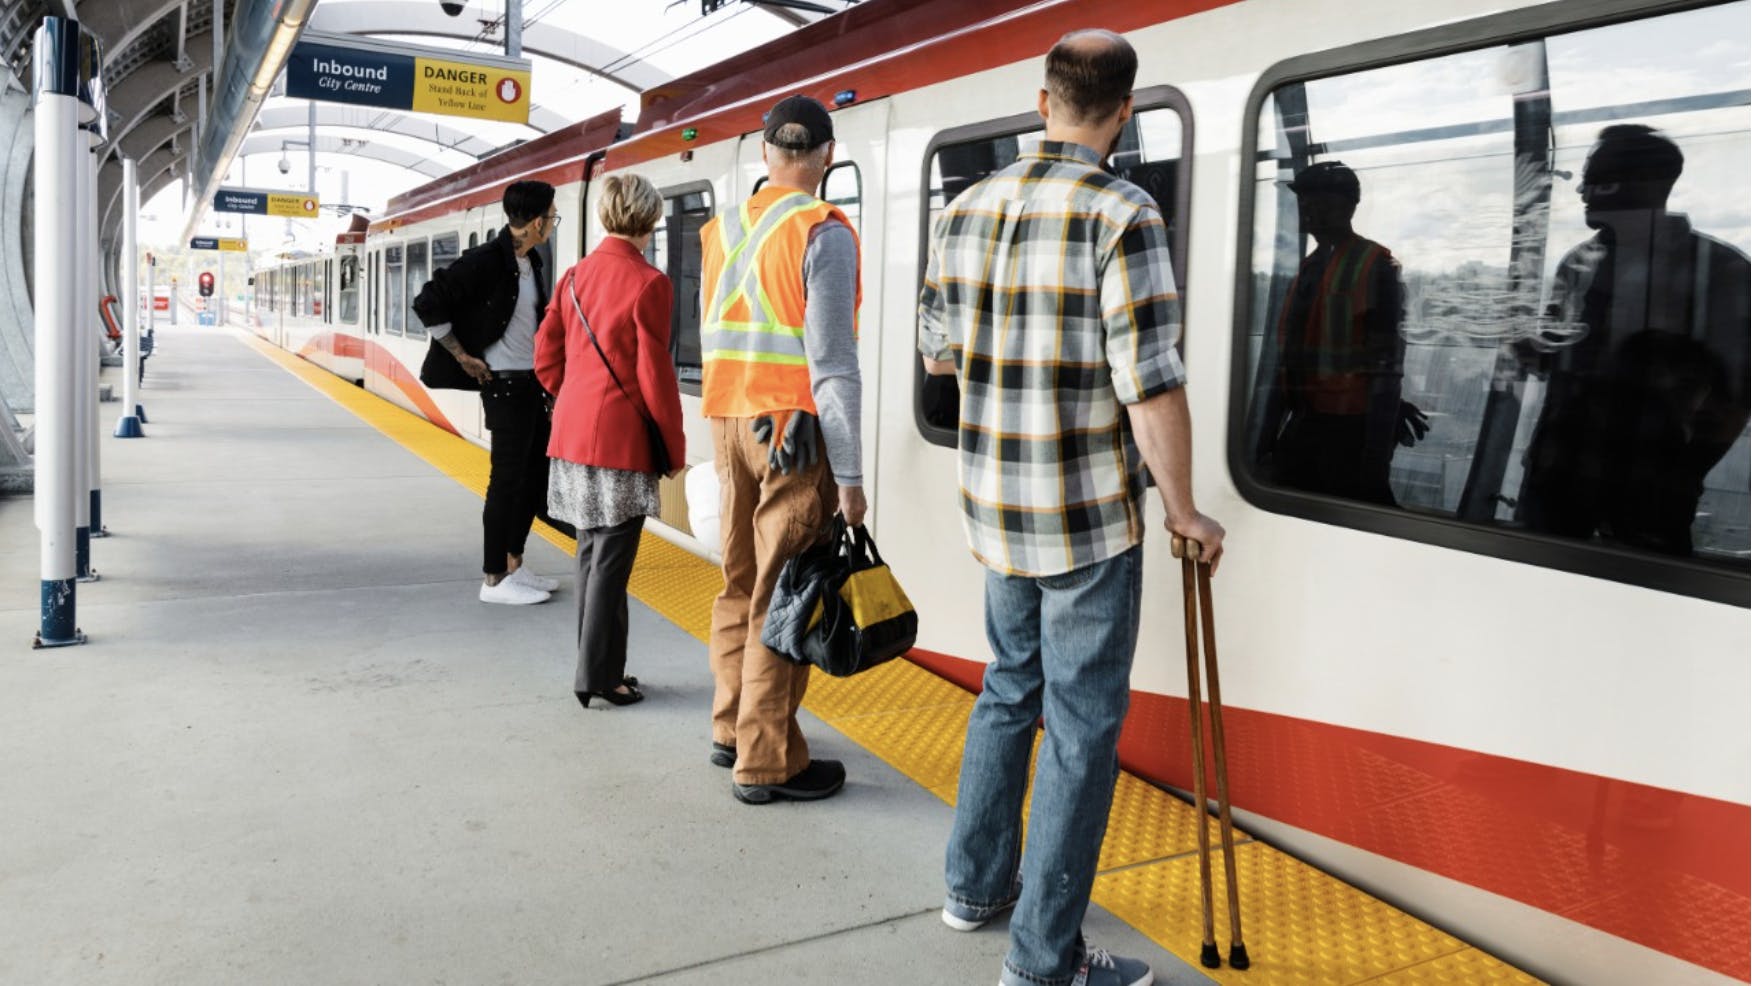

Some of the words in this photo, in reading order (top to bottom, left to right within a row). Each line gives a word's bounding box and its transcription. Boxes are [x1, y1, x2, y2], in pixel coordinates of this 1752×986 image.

[313, 58, 388, 80] Inbound
[424, 66, 488, 85] DANGER
[319, 76, 341, 91] City
[344, 80, 382, 94] Centre
[429, 84, 453, 95] Stand
[455, 86, 477, 97] Back
[479, 89, 488, 98] of
[438, 98, 466, 108] Yellow
[468, 101, 487, 111] Line
[225, 196, 258, 205] Inbound
